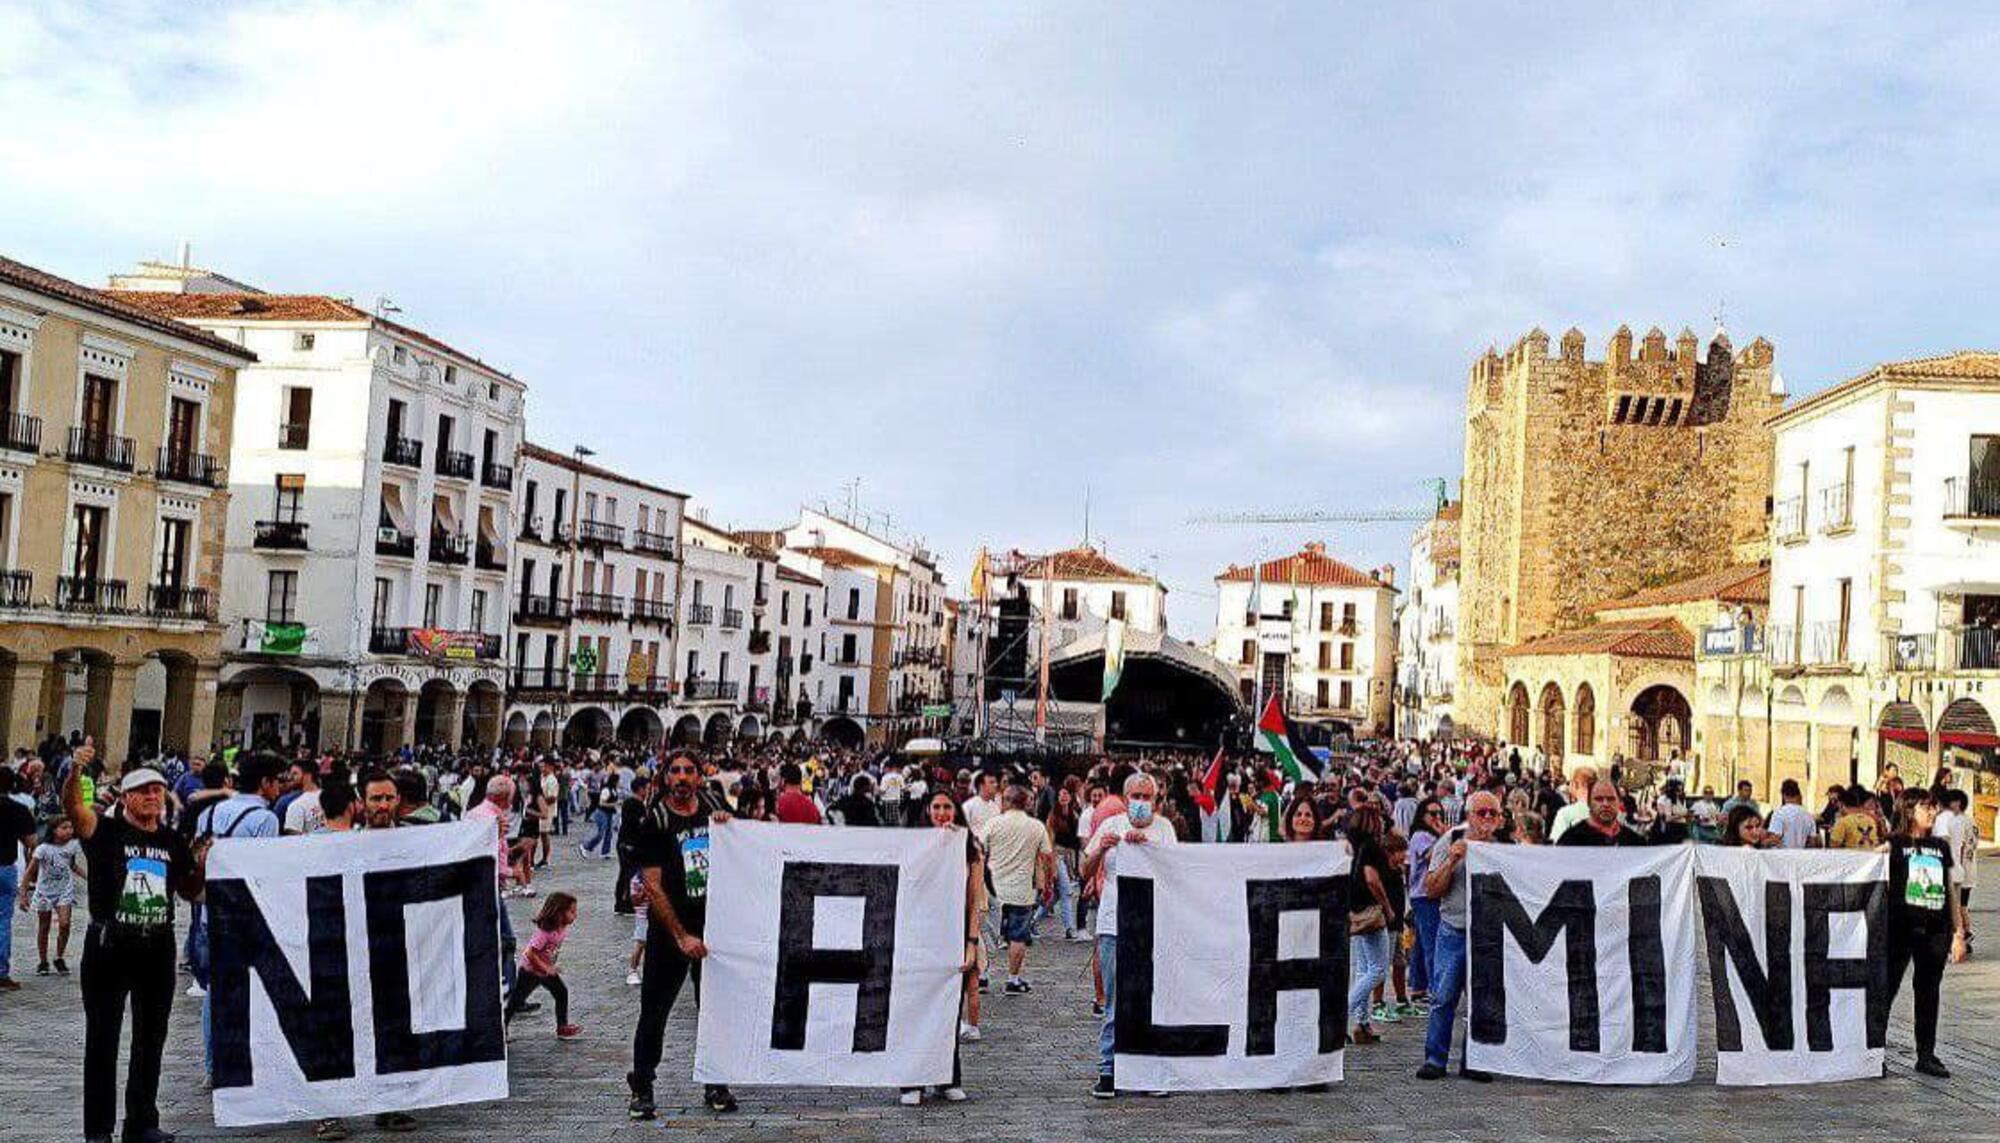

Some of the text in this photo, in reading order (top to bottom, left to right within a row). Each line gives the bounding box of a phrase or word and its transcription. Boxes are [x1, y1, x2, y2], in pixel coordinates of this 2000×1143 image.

[124, 845, 172, 862] NO MINA
[206, 856, 1889, 1088] NO A LA MINA
